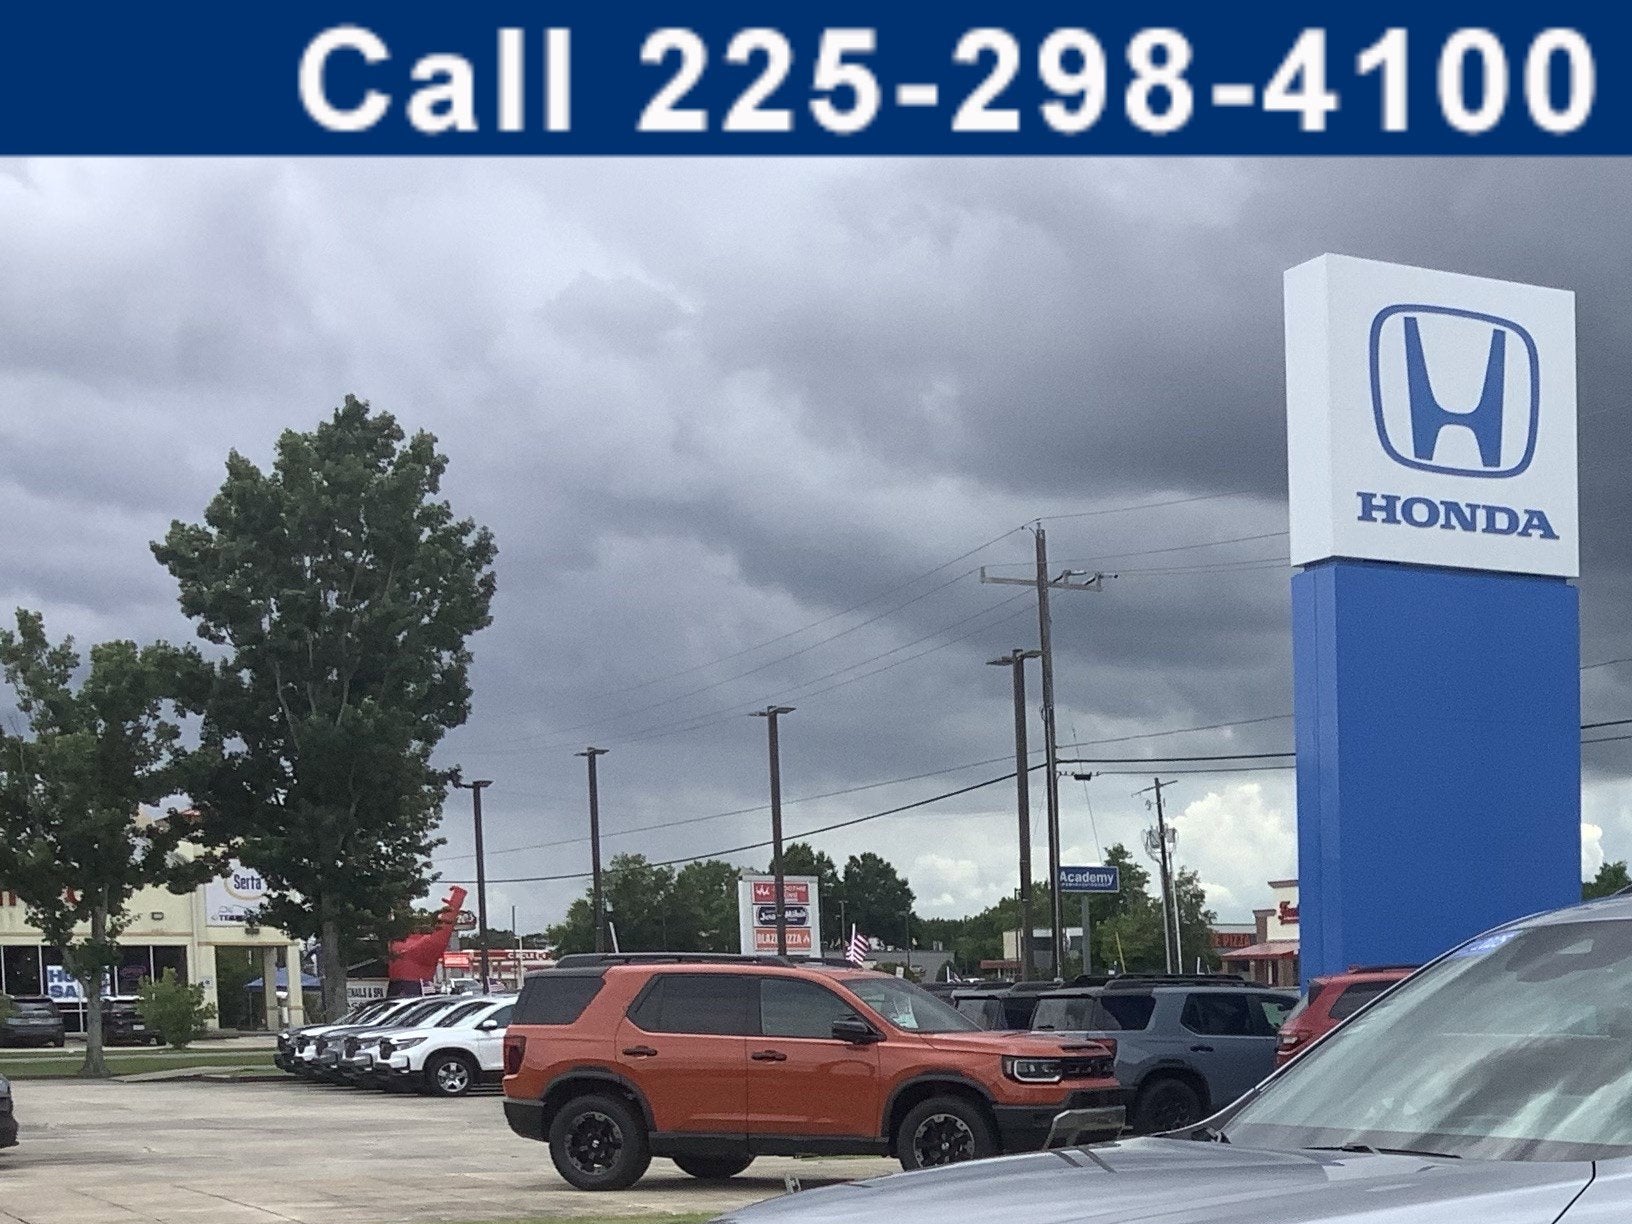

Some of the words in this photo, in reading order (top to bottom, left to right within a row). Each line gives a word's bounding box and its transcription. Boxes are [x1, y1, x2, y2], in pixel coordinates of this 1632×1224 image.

[1356, 491, 1560, 540] HONDA
[233, 873, 262, 890] Serta
[1060, 871, 1114, 886] Academy
